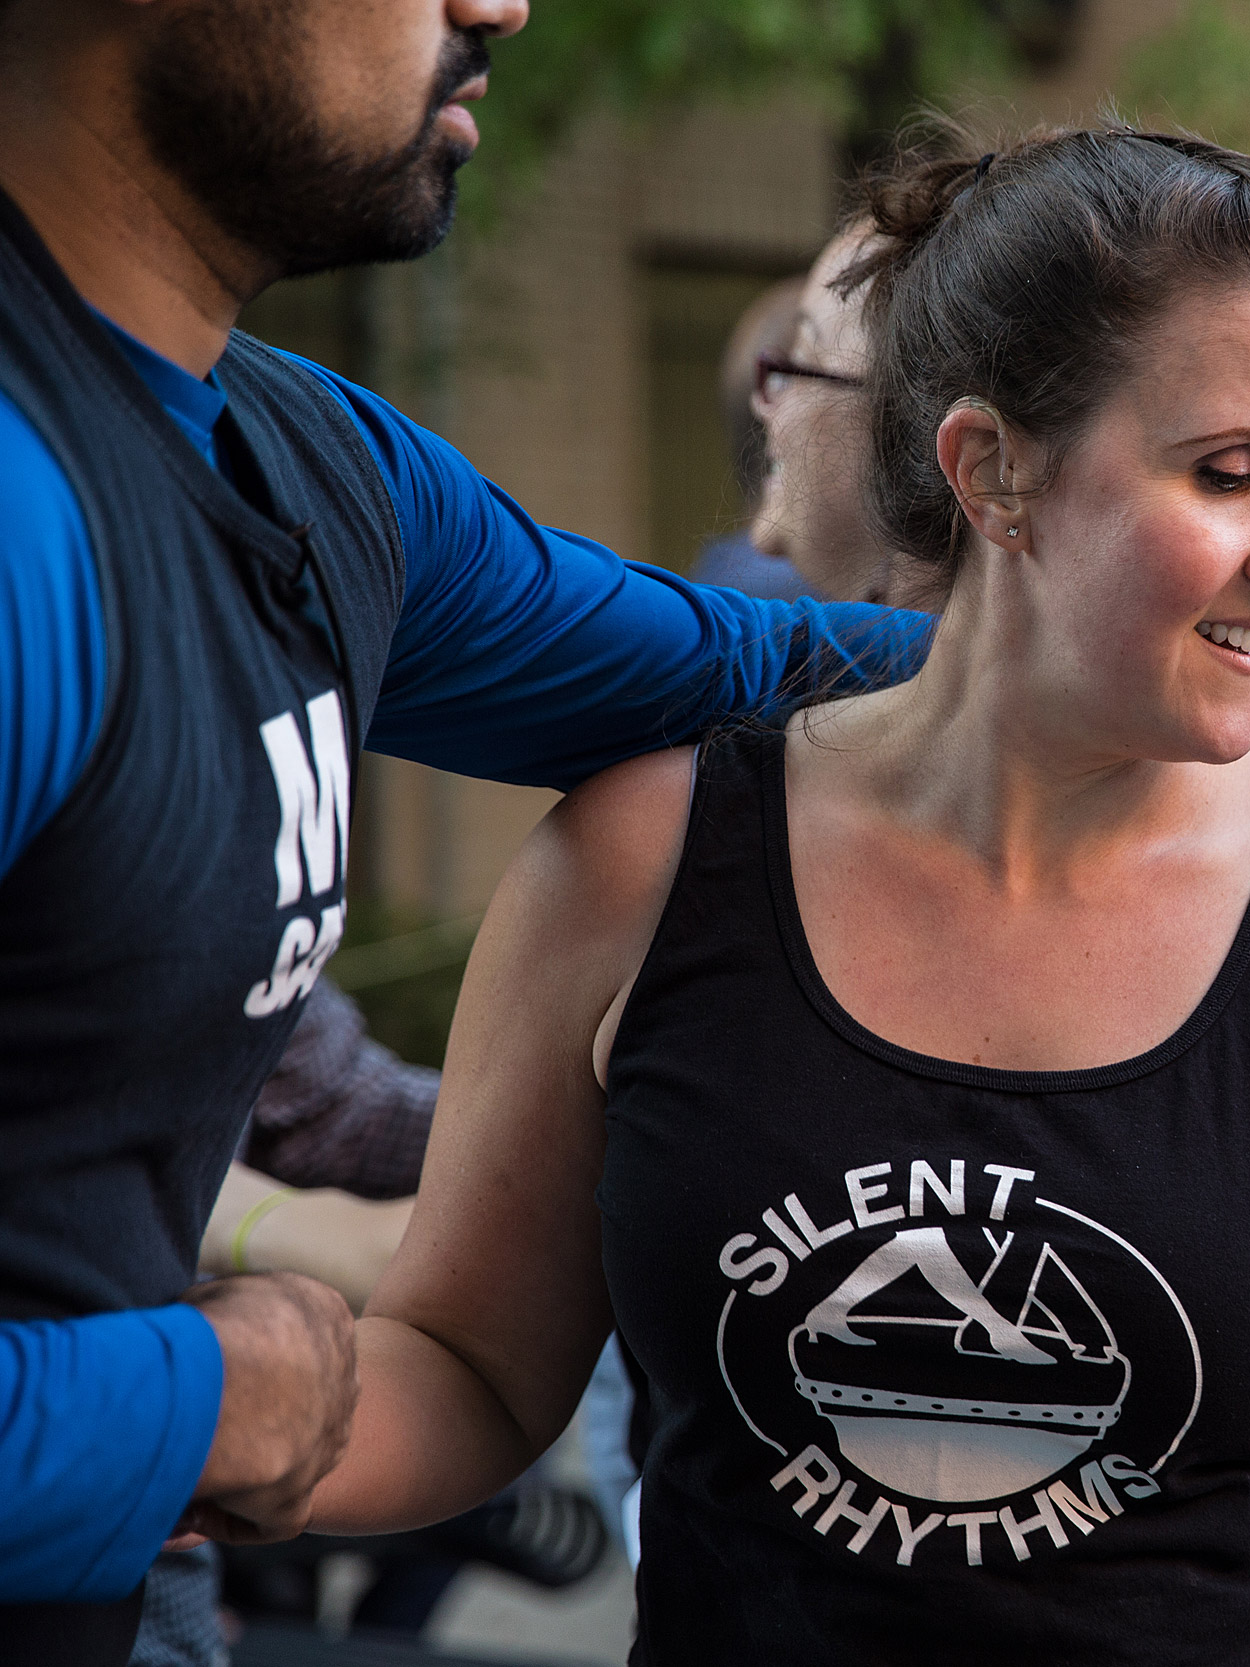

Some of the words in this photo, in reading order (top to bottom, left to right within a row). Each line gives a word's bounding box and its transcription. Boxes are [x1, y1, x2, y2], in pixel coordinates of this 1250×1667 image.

[243, 899, 347, 1018] SA
[719, 1159, 1035, 1296] SILENT
[769, 1444, 1161, 1566] RHYTHMS
